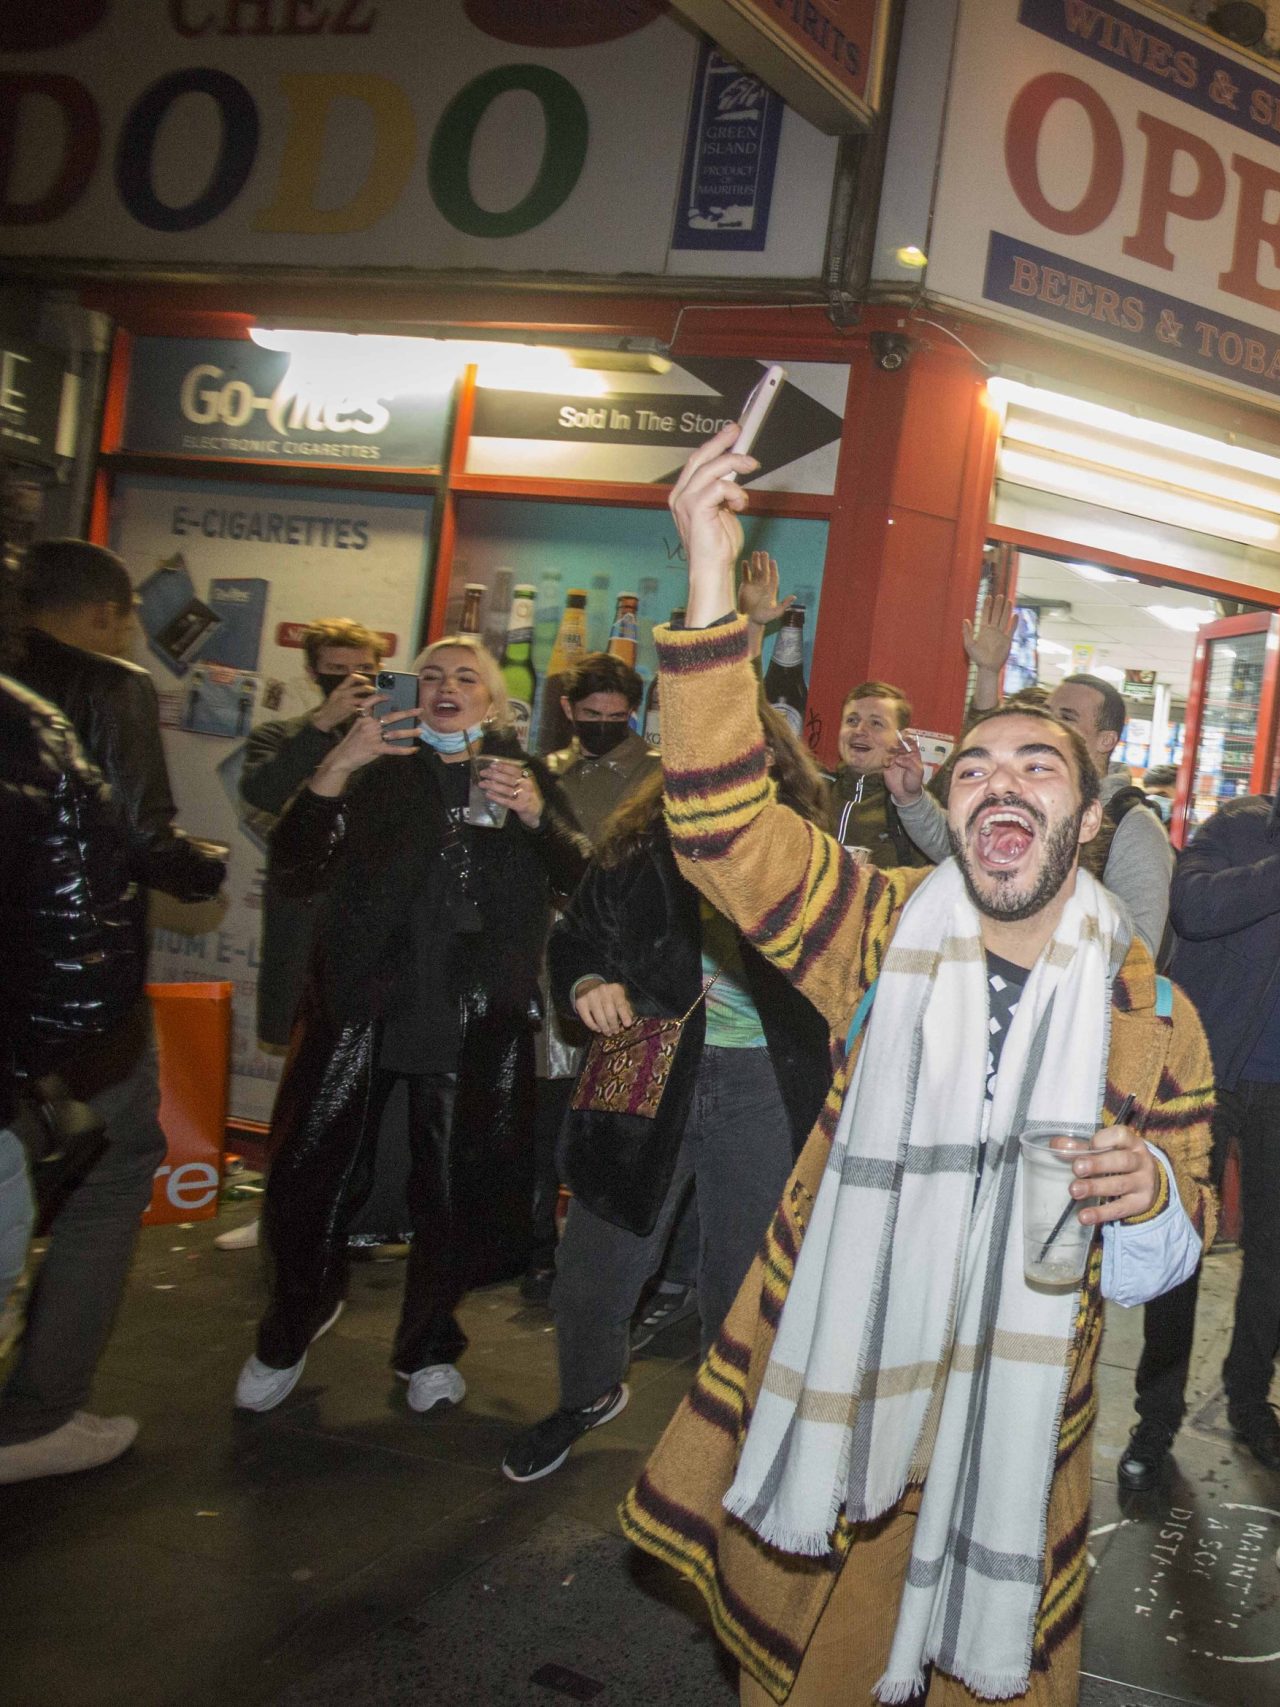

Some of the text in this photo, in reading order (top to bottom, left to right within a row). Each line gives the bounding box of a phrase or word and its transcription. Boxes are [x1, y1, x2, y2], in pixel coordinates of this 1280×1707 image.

[770, 0, 861, 77] IRITS
[1063, 1, 1198, 90] WINES
[1208, 69, 1240, 110] &
[706, 125, 758, 139] GREEN
[0, 62, 590, 239] DODO
[702, 141, 758, 155] ISLAND
[702, 165, 755, 177] PRODUCT
[698, 184, 756, 195] MAURITIUS
[1009, 255, 1146, 334] BEERS
[1155, 308, 1183, 348] &
[558, 405, 734, 433] Sold In The Store
[183, 435, 381, 460] ELECTRONIC CIGARETTES
[171, 505, 369, 551] E-CIGARETTES
